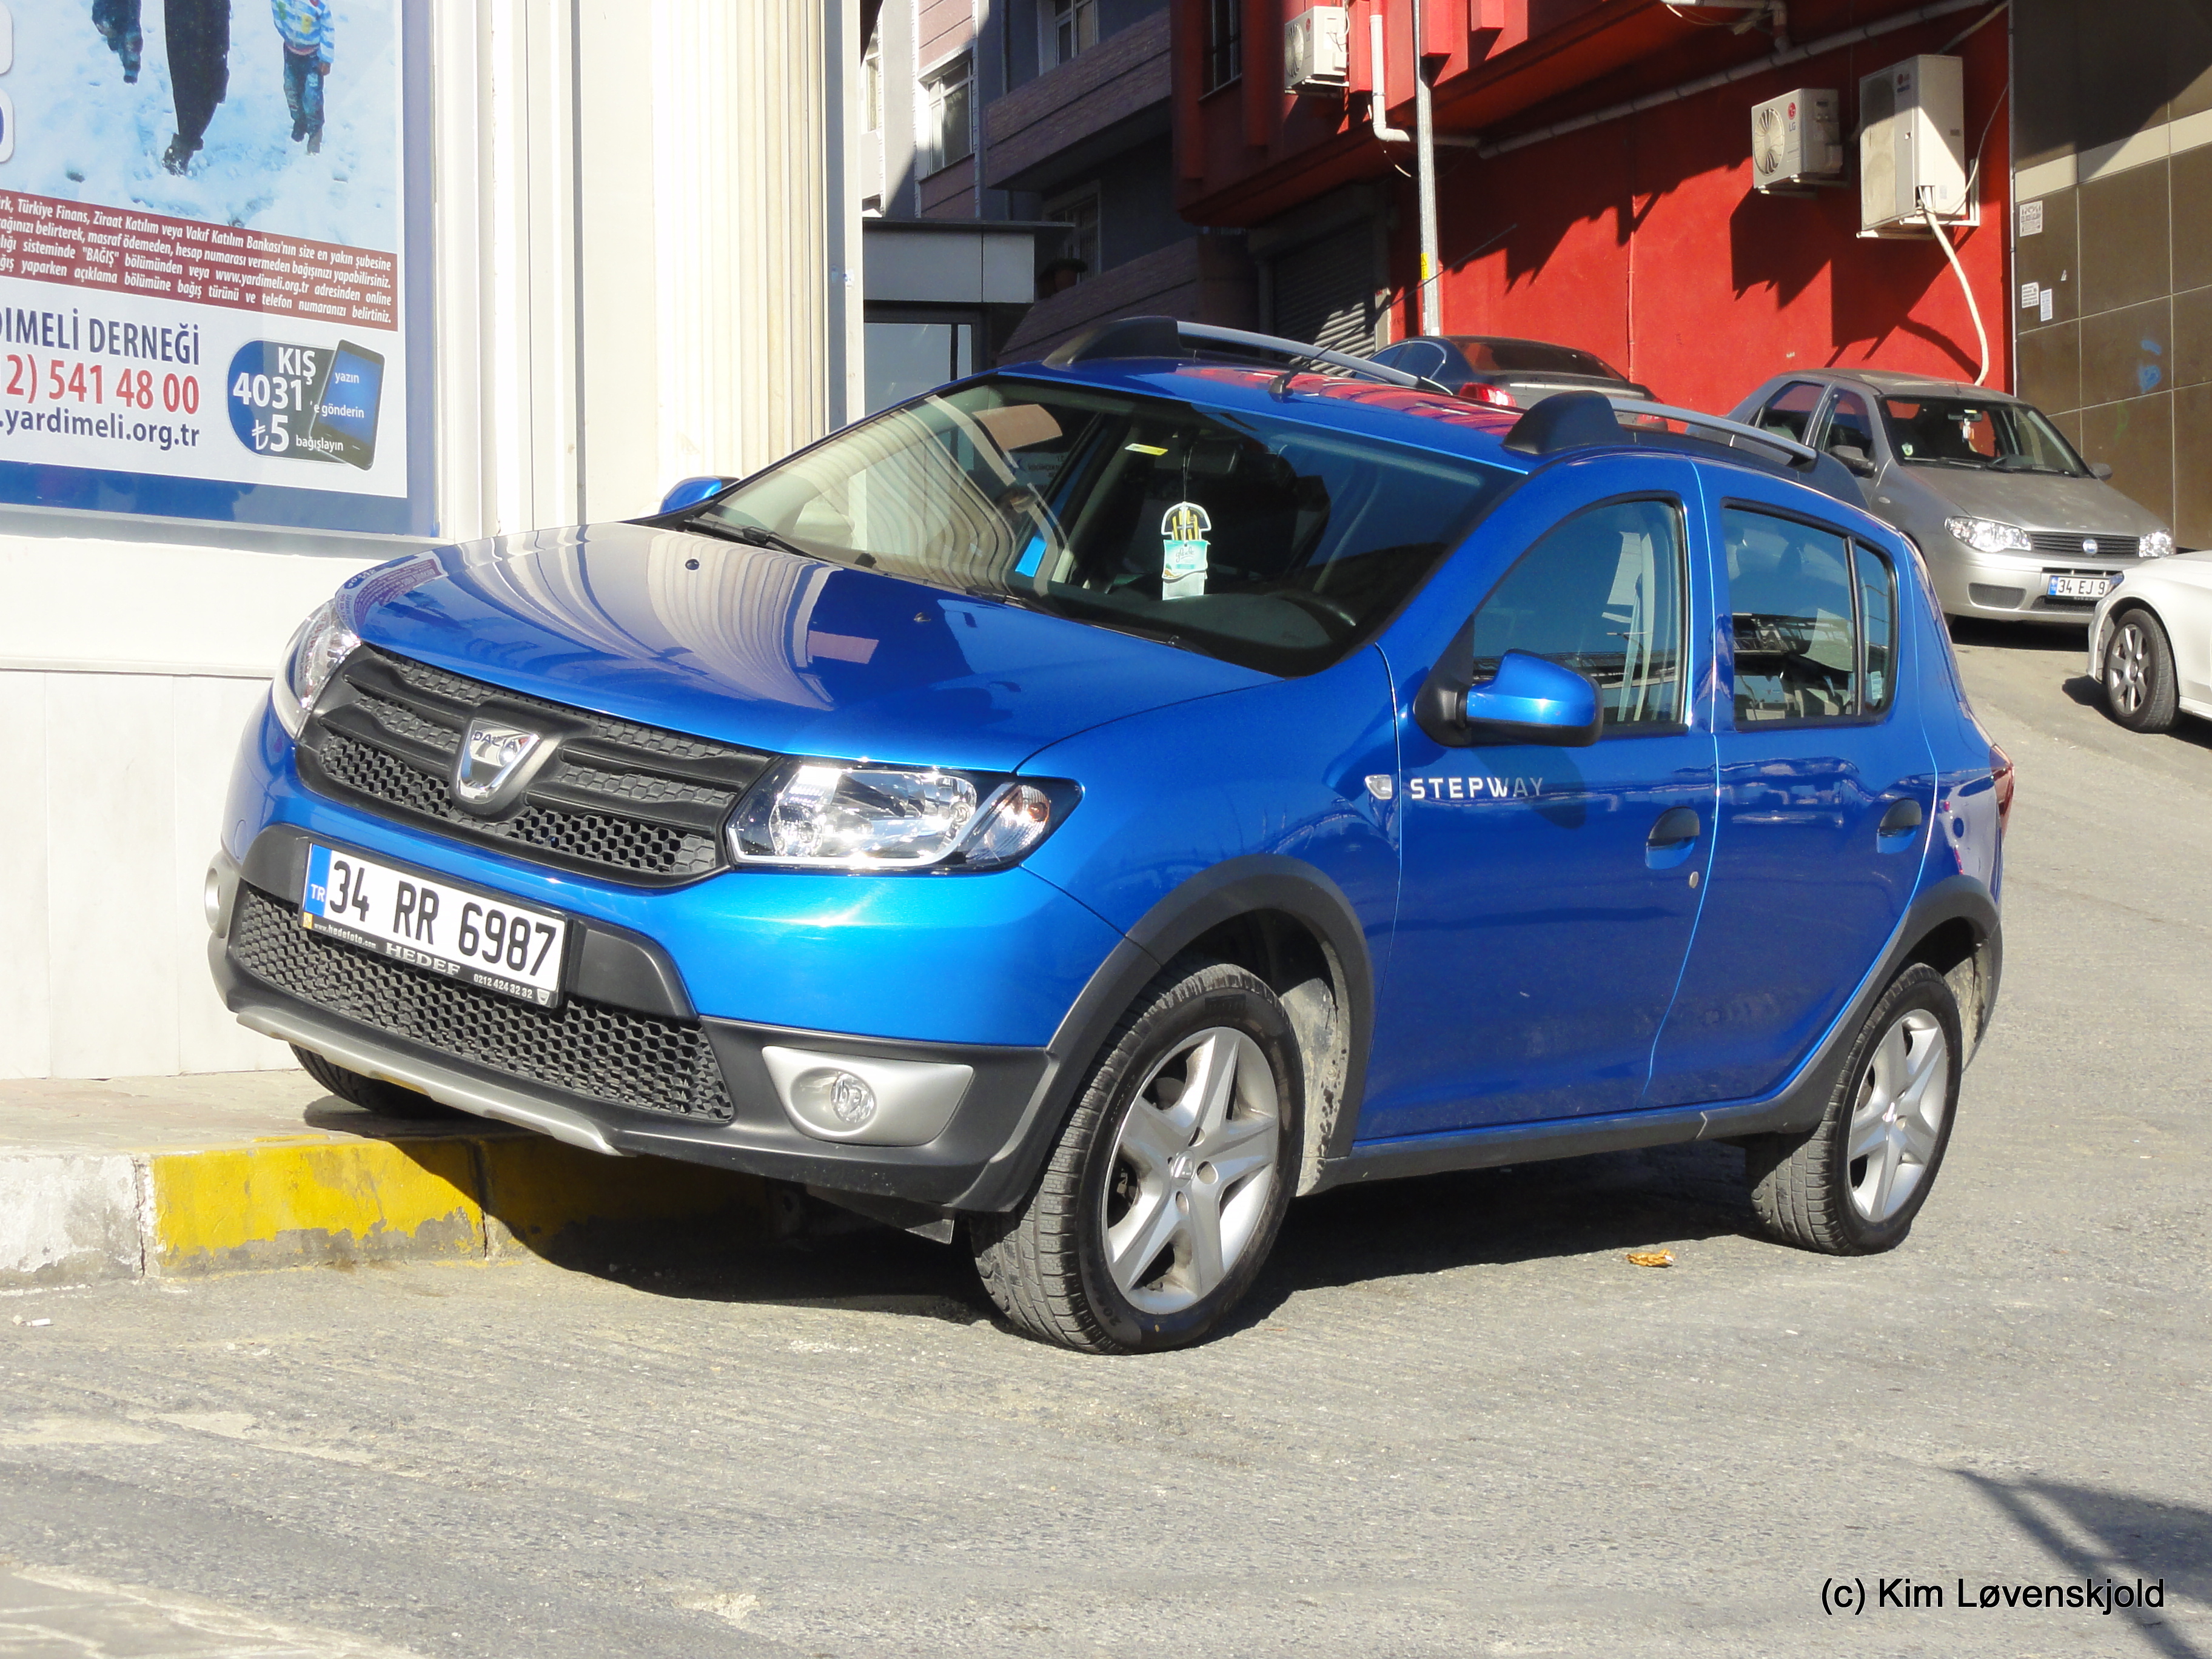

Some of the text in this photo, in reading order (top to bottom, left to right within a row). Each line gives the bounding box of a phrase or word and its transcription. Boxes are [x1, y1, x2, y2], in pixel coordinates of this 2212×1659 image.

[0, 195, 391, 271] rk, Türkiye Finans, Ziraat Katılım veya Vakıf Katılım Bankası'nın size en yakın şubesine
[0, 216, 391, 289] ağınızı belirterek, masraf ödemeden, hesap numarası vermeden bağışınızı yapabilirsiniz.
[0, 234, 391, 306] lığı sisteminde "BAĞIŞ" bölümünden veya www.yardimeli.org.tr adresinden online
[21, 260, 67, 276] yaparken
[74, 266, 118, 283] açıklama
[124, 272, 171, 291] bölümüne
[178, 280, 202, 298] bağış
[209, 284, 239, 301] türünü
[246, 293, 256, 303] ve
[262, 293, 292, 309] telefon
[298, 300, 346, 317] numaranızı
[352, 305, 391, 323] belirtiniz.
[0, 307, 199, 365] IMELİ DERNEĞİ
[278, 347, 360, 385] KIŞ yazın
[49, 359, 102, 404] 541
[116, 368, 154, 410] 48
[163, 373, 199, 415] 00
[233, 372, 302, 411] 4031
[321, 403, 364, 418] gönderin
[296, 434, 344, 452] bağışlayın
[2058, 579, 2073, 594] 34
[2078, 580, 2094, 594] EJ
[473, 731, 517, 749] DACIA
[1410, 777, 1543, 799] STEPWAY
[310, 883, 326, 902] TR
[314, 924, 376, 948] www.hedefoto.com
[329, 860, 557, 977] 34 RR 6987
[386, 942, 461, 976] HEDEF
[474, 973, 532, 999] 0212 424 32 32
